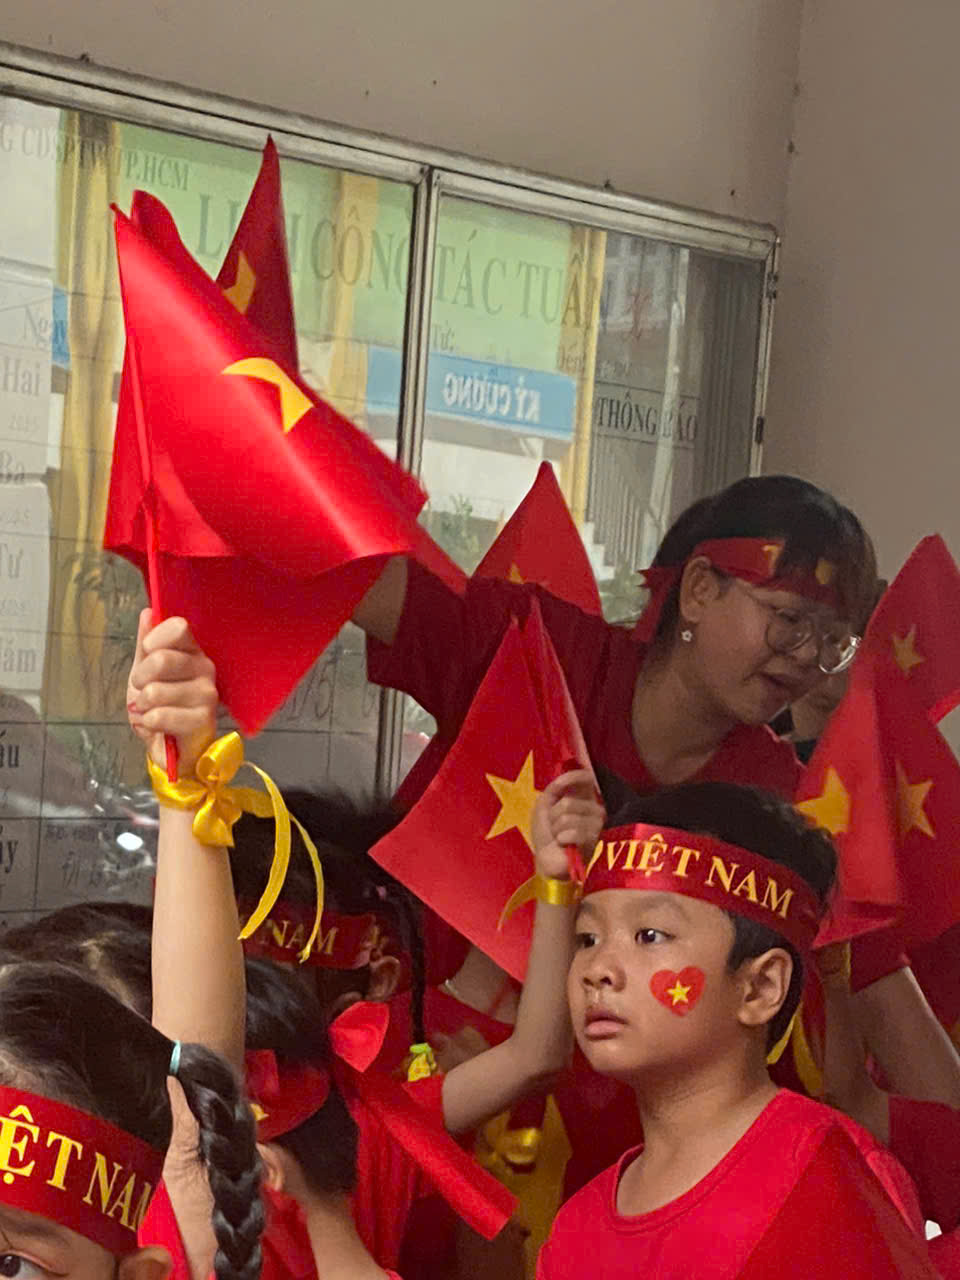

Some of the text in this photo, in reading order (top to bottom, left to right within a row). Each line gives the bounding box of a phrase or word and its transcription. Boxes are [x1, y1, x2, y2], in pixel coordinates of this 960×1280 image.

[596, 390, 657, 437] THÔNG
[606, 833, 796, 919] VIỆT NAM
